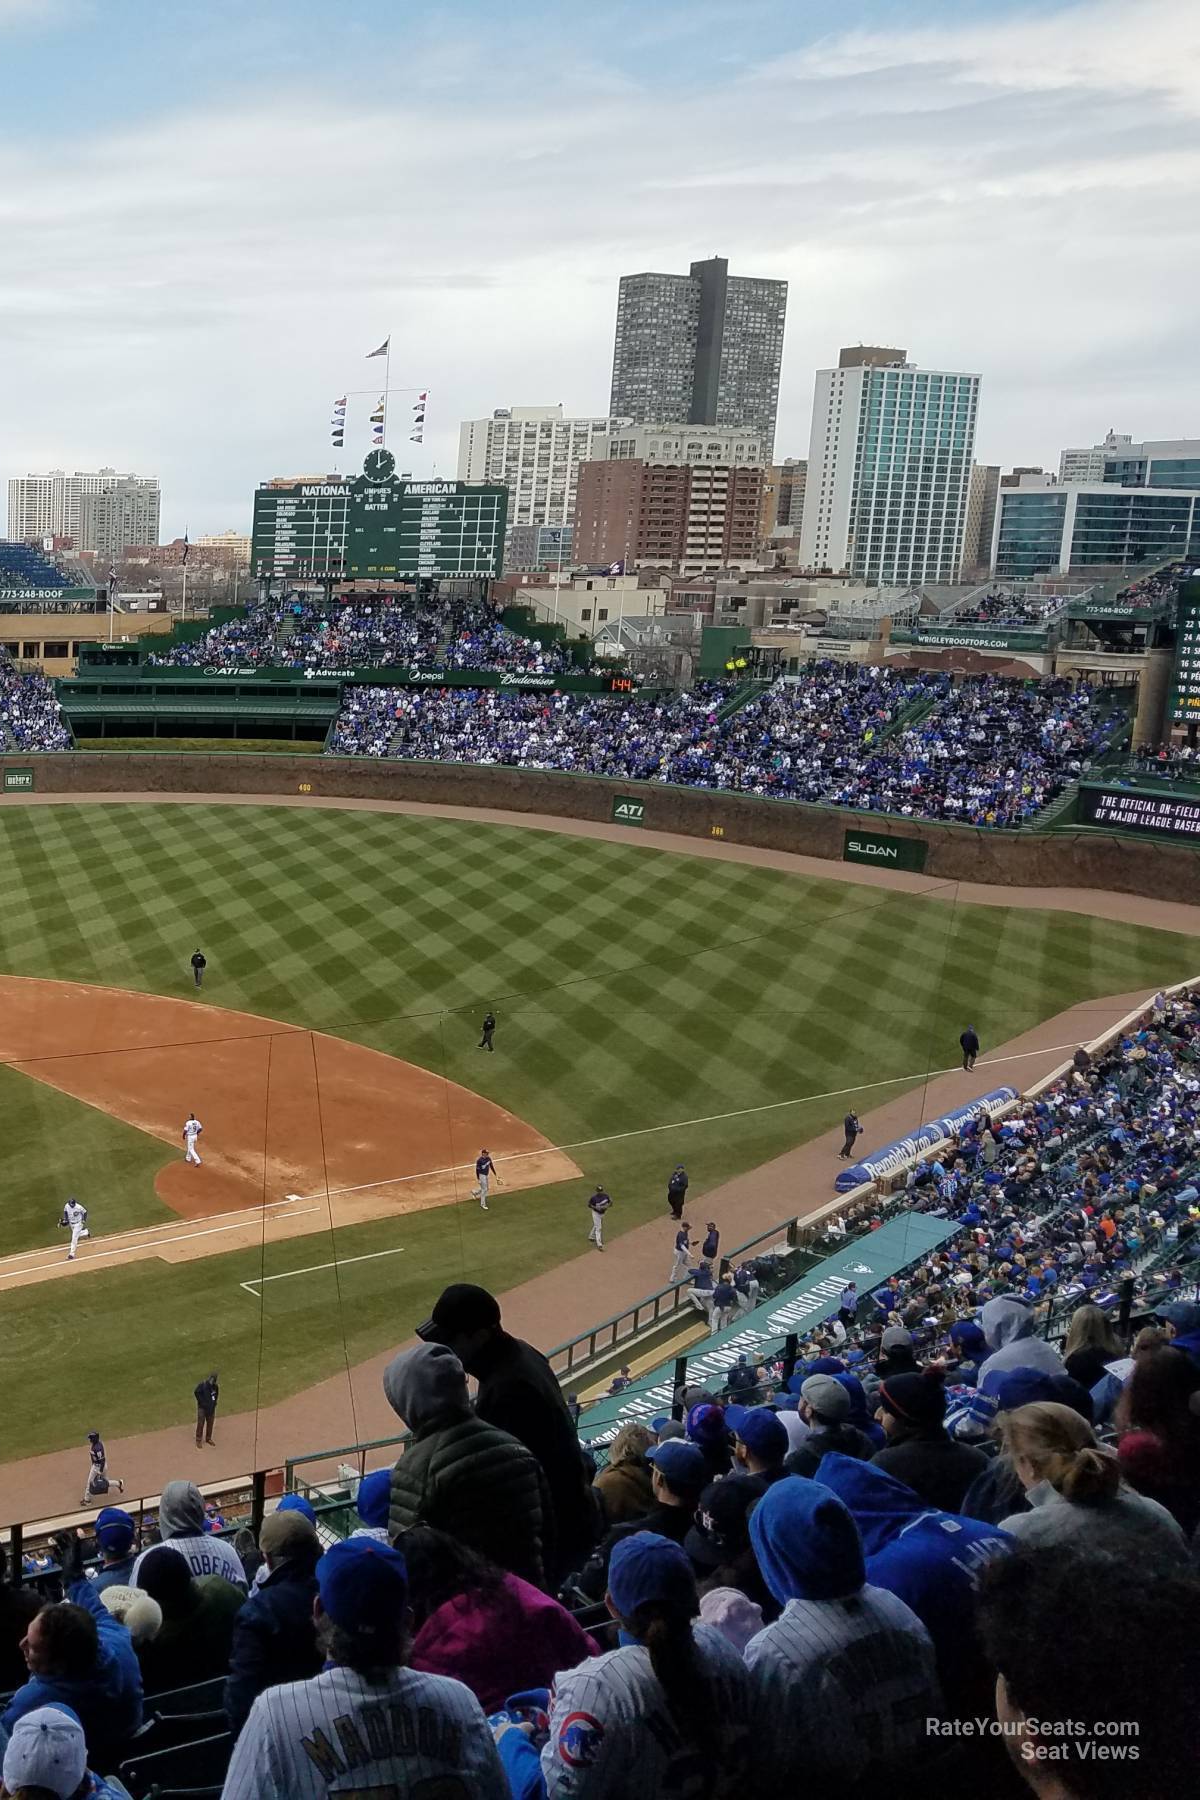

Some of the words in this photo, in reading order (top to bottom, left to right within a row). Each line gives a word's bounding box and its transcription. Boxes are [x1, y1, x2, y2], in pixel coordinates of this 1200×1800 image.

[301, 485, 351, 496] NATIONAL
[404, 483, 457, 494] AMERICAN
[364, 503, 388, 511] BATTER
[0, 589, 63, 599] 773-248-ROOF
[1085, 605, 1133, 615] 773-248-ROOF
[1191, 607, 1196, 615] 6
[1185, 620, 1194, 628] 22
[918, 635, 1008, 648] WRIGLEYROOFTOPS.COM
[1183, 633, 1193, 641] 24
[1182, 646, 1191, 654] 21
[1180, 659, 1189, 667] 16
[217, 667, 239, 675] ATI
[315, 669, 355, 677] Advocate
[421, 671, 444, 681] pepsi
[1179, 671, 1188, 679] 14
[500, 672, 556, 686] Budweiser
[611, 678, 632, 691] 1:44
[1177, 685, 1186, 693] 18
[1173, 710, 1183, 718] 35
[1101, 795, 1118, 807] THE
[1120, 797, 1156, 813] OFFICIAL
[615, 804, 644, 816] ATI
[1095, 808, 1106, 819] OF
[1108, 809, 1138, 823] MAJOR
[1140, 814, 1172, 828] LEAGUE
[848, 841, 897, 858] SLOAN
[862, 1146, 907, 1181] Reynolds
[900, 1136, 931, 1158] Wrap
[810, 1275, 853, 1298] FIELD
[767, 1292, 828, 1325] WRIGLEY
[766, 1320, 790, 1334] of
[701, 1329, 773, 1368] CONFINES
[617, 1398, 663, 1420] THE
